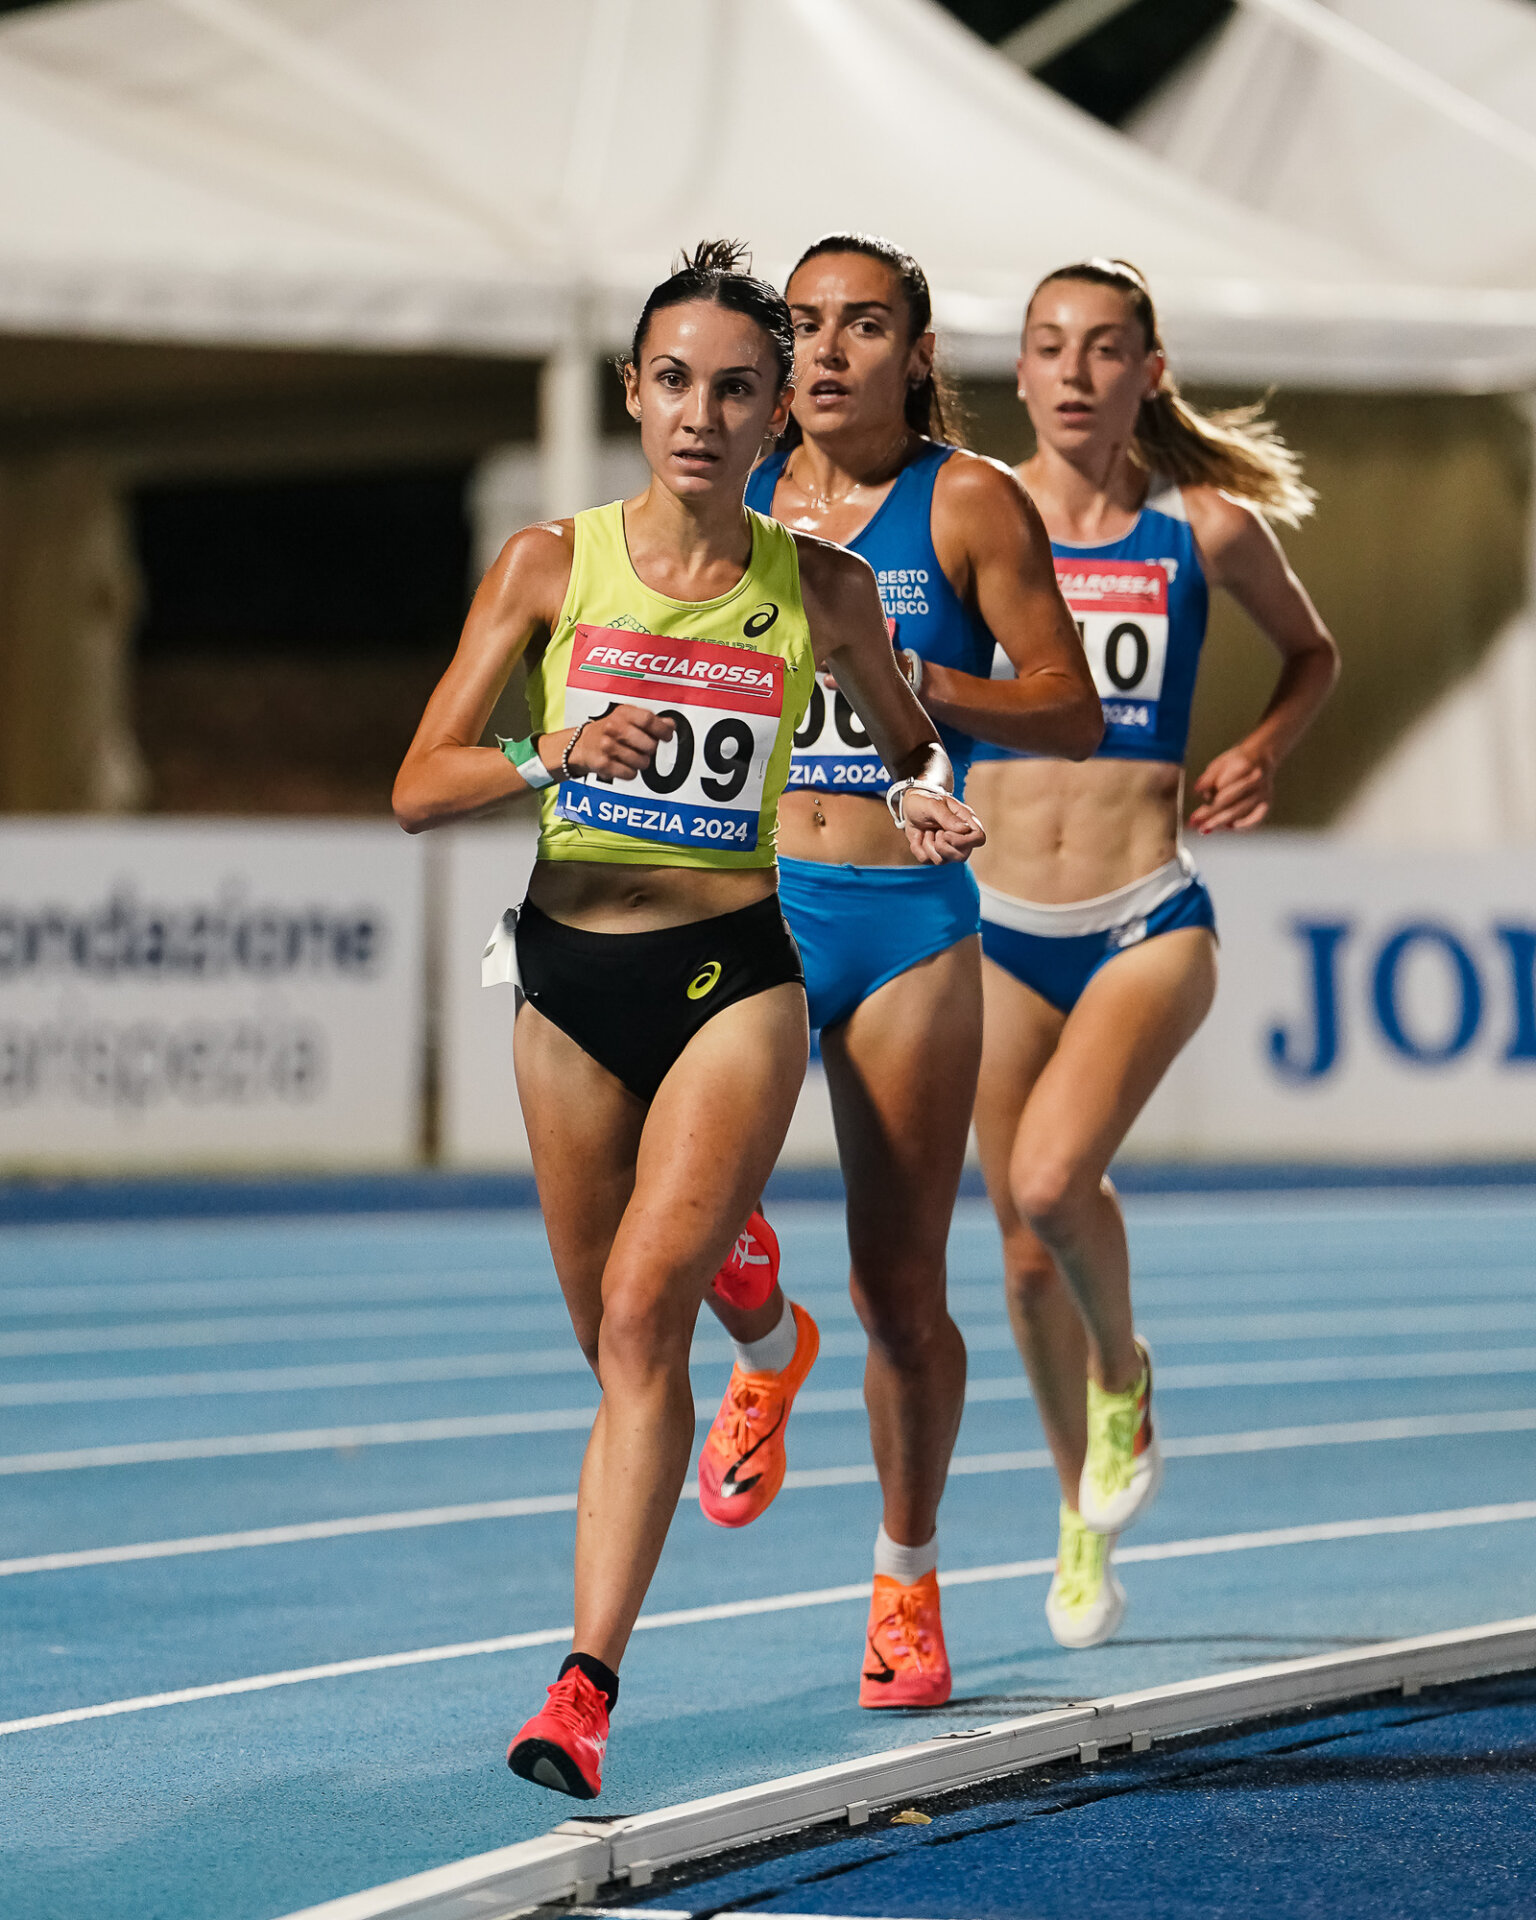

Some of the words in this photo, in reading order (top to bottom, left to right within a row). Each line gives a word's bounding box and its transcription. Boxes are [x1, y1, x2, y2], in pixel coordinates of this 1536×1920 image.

[878, 569, 929, 585] SESTO
[585, 646, 774, 689] FRECCIAROSSA
[1076, 621, 1150, 691] 0
[832, 764, 893, 784] 2024
[565, 791, 592, 817] LA
[598, 801, 685, 834] SPEZIA
[690, 817, 748, 842] 2024
